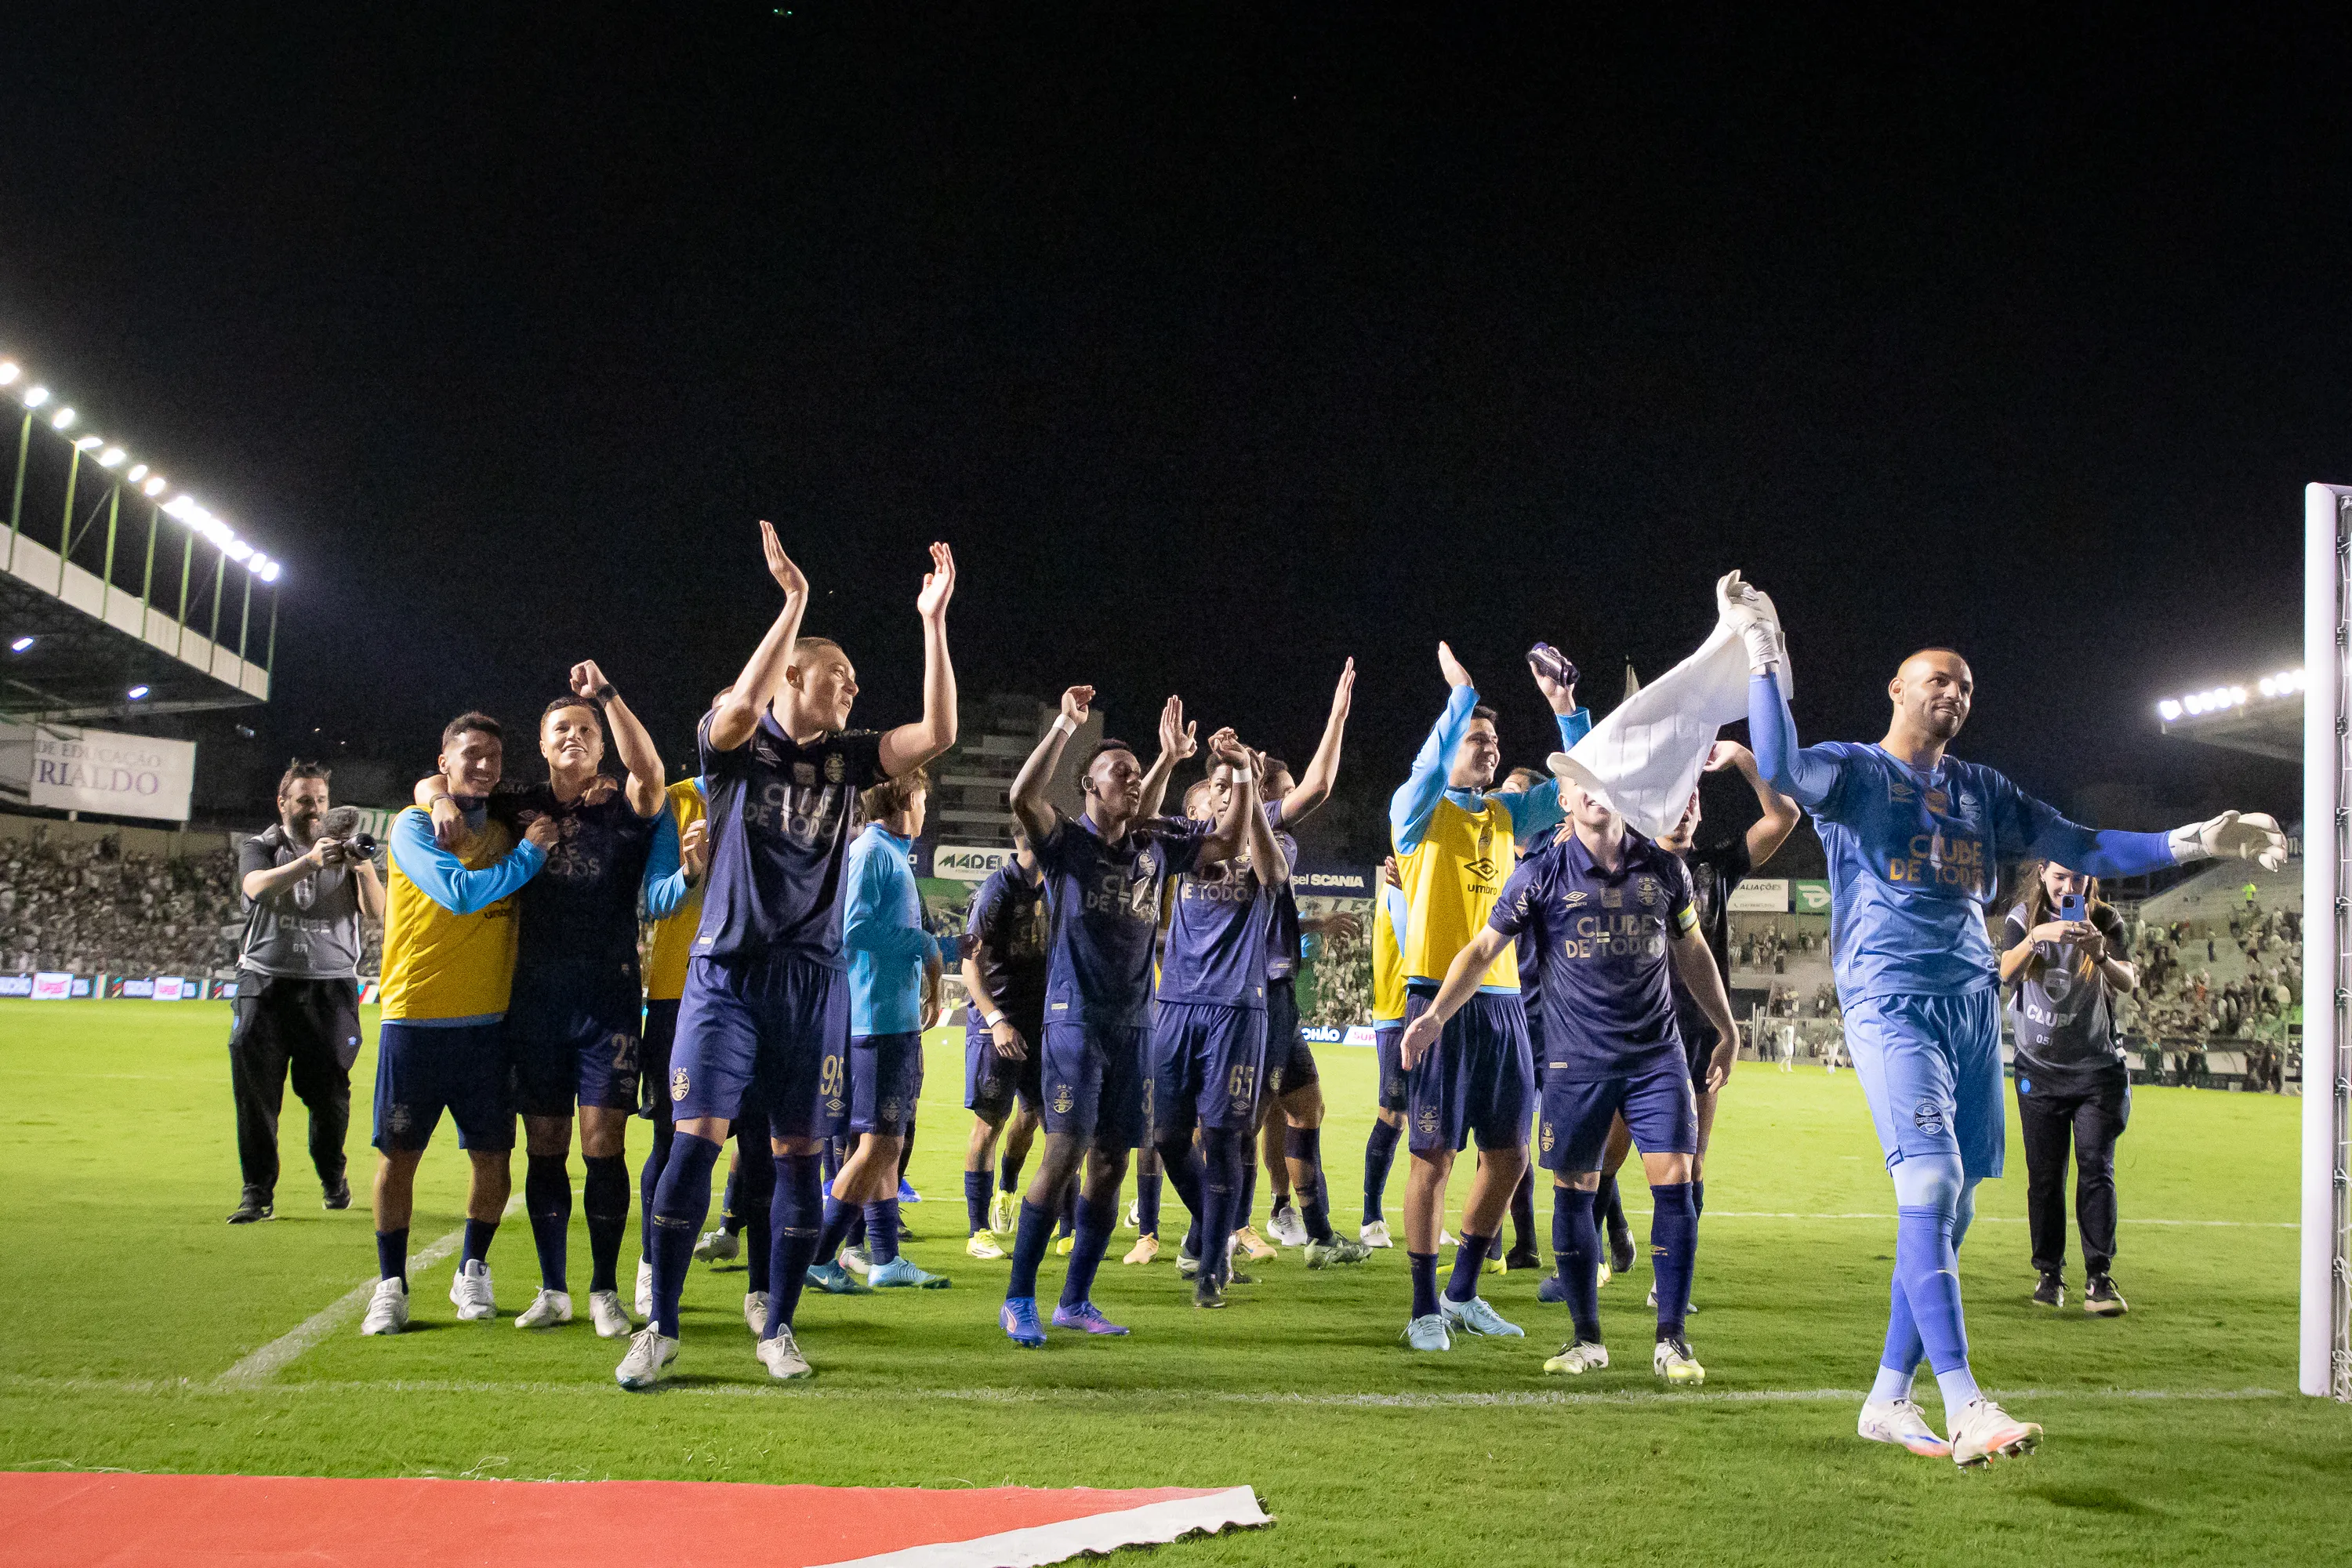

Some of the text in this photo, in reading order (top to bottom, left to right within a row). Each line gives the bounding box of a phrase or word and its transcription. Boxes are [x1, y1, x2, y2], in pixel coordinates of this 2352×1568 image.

[1889, 858, 1922, 882] DE
[1310, 873, 1365, 887] SCANIA
[1468, 884, 1497, 895] umbro
[1737, 883, 1782, 891] ALIAÇÕES
[1198, 884, 1248, 902] TODO
[1577, 914, 1655, 938] CLUBE
[1565, 939, 1592, 959] DE
[820, 1054, 844, 1098] 95
